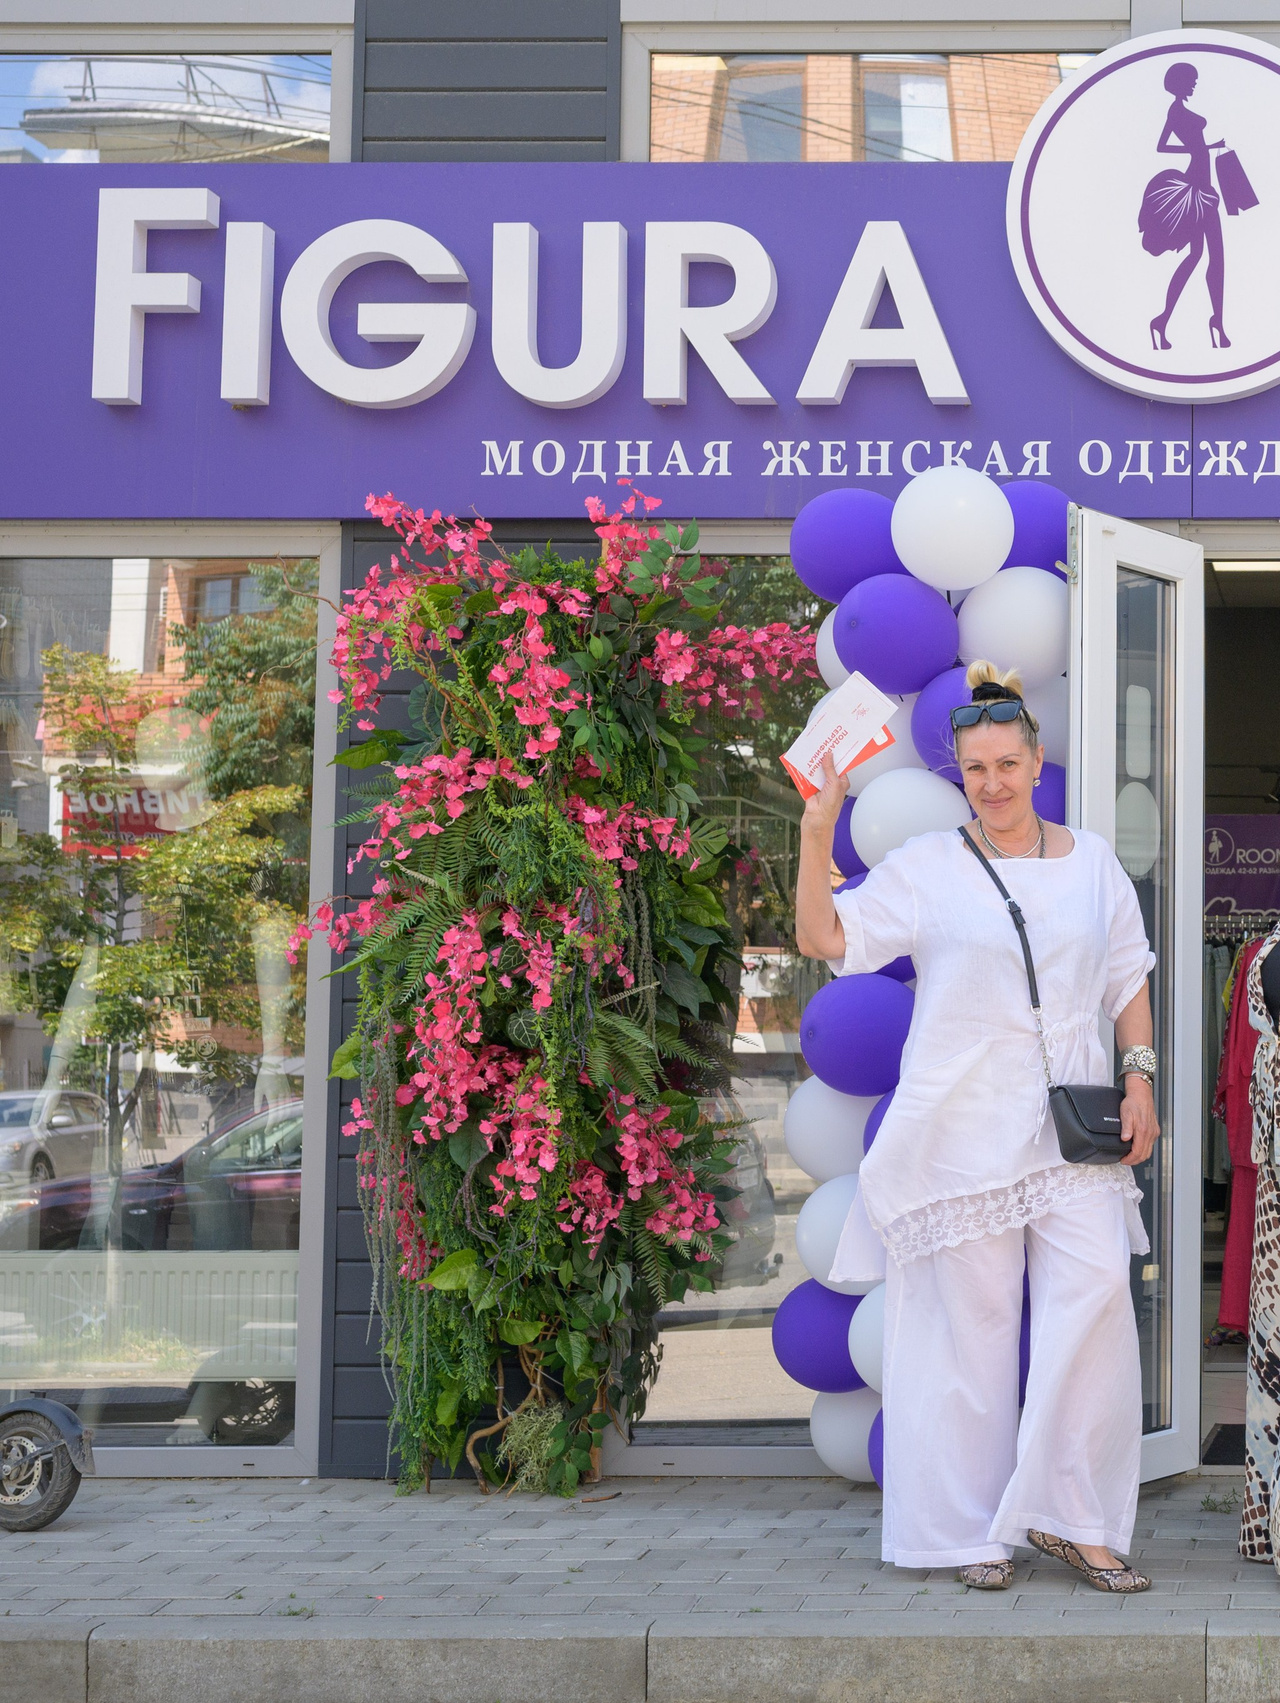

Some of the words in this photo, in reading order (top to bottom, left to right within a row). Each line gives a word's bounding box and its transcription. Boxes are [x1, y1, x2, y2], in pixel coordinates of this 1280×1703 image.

[91, 187, 969, 408] FIGURA
[480, 439, 733, 484] МОДНАЯ
[760, 439, 1052, 476] ЖЕНСКАЯ
[806, 724, 843, 769] СЕРТИФИКАТ
[1205, 867, 1236, 876] ОДЕЖДА
[1237, 867, 1258, 875] 42-62
